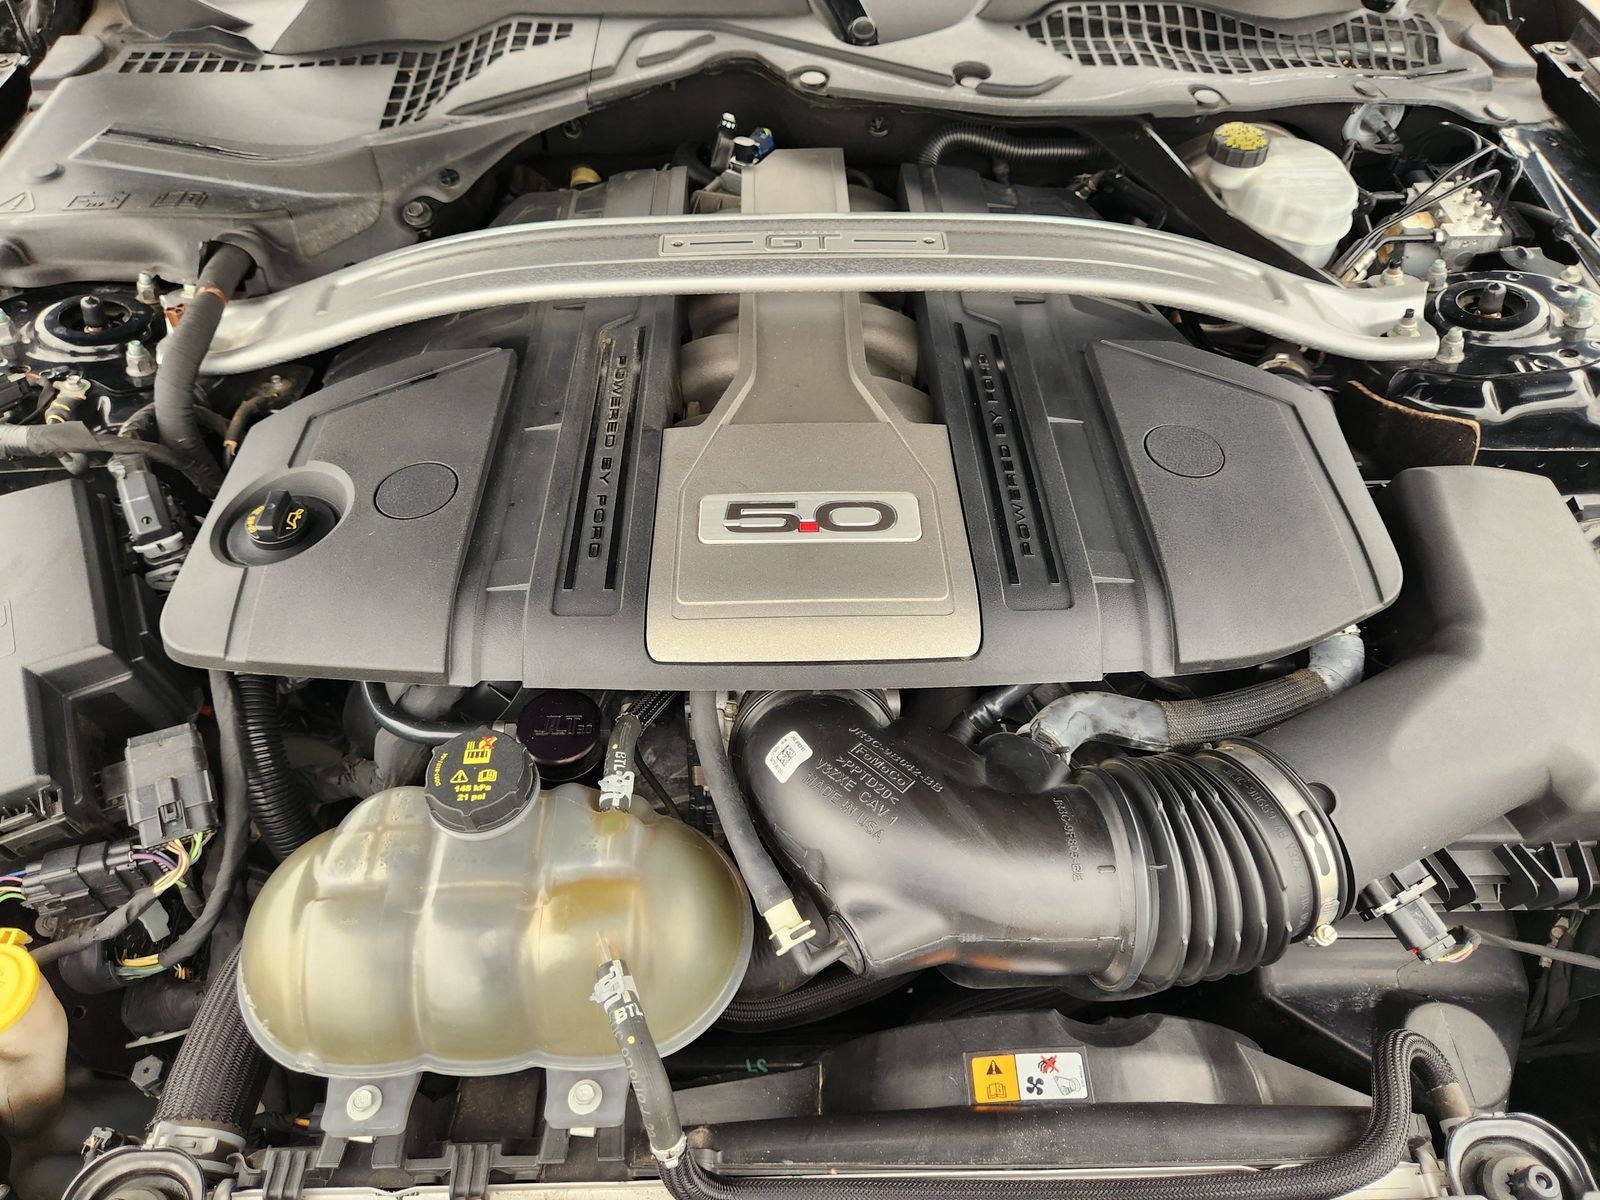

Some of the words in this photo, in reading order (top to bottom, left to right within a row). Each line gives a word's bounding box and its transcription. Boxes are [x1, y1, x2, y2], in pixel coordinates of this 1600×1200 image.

[765, 233, 841, 251] GT
[604, 355, 627, 449] POWERED
[989, 410, 1007, 437] BY
[599, 457, 613, 485] BY
[723, 500, 898, 533] 5.0
[999, 444, 1035, 558] POWERED
[588, 494, 608, 559] FORD
[534, 714, 583, 736] JLT
[855, 746, 906, 787] FoMoCo
[801, 773, 843, 804] MADE
[840, 800, 858, 817] IN
[857, 812, 886, 844] USA
[859, 791, 890, 817] CAV
